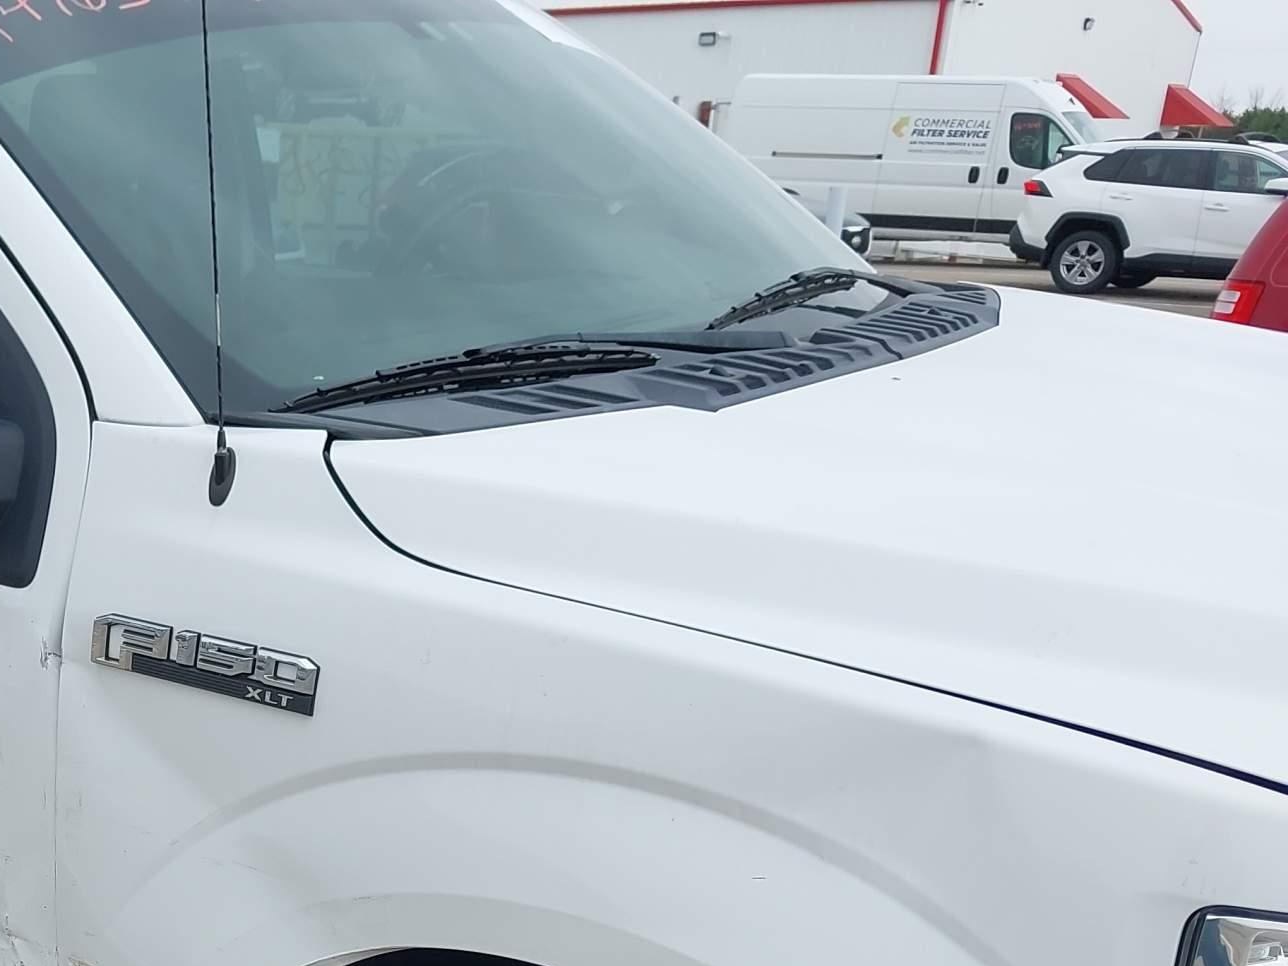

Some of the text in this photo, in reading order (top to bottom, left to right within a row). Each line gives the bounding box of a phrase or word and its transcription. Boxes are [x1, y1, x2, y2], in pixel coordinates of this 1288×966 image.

[913, 118, 992, 129] COMMERCIAL
[910, 129, 991, 138] FILTER SERVICE
[245, 684, 294, 708] XLT
